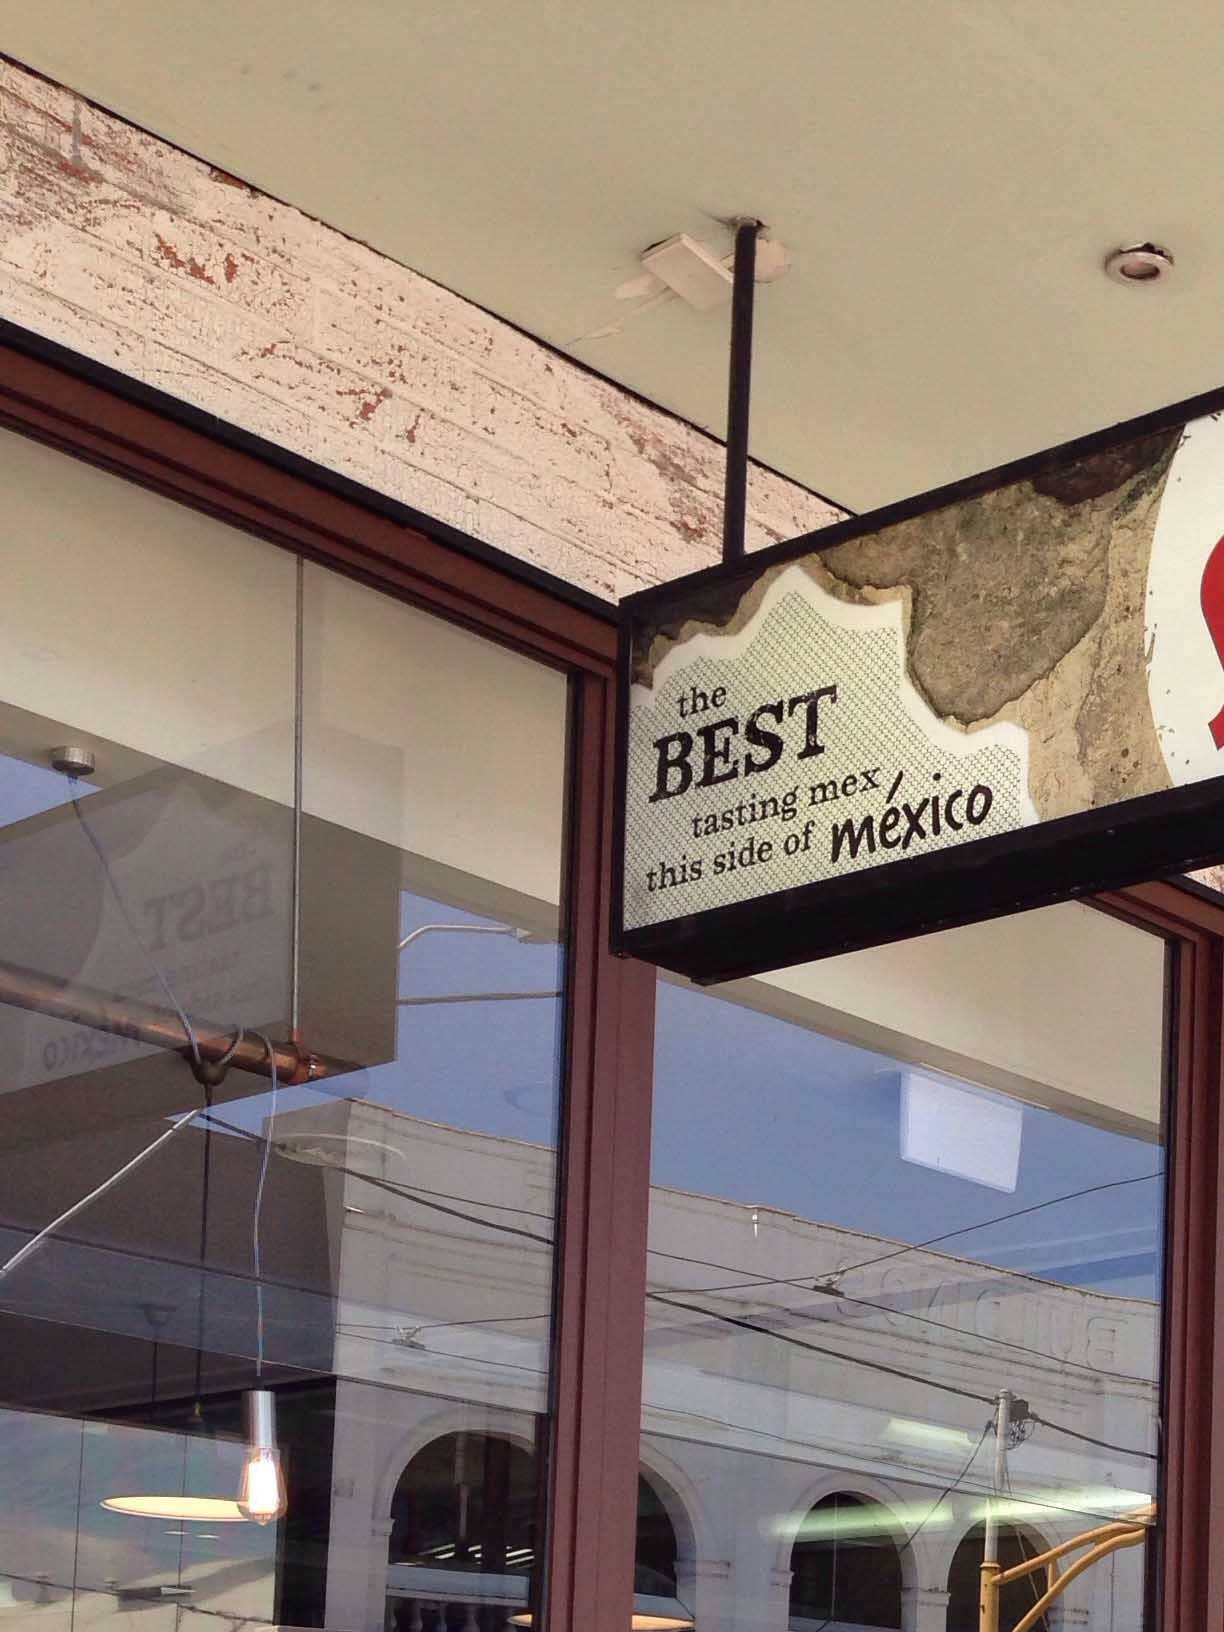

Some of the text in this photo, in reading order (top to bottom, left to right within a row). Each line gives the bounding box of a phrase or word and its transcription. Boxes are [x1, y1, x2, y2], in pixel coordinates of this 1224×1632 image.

[647, 684, 838, 804] BEST
[677, 685, 728, 719] the
[645, 769, 994, 893] this side of méxico
[692, 766, 881, 839] tasting mex
